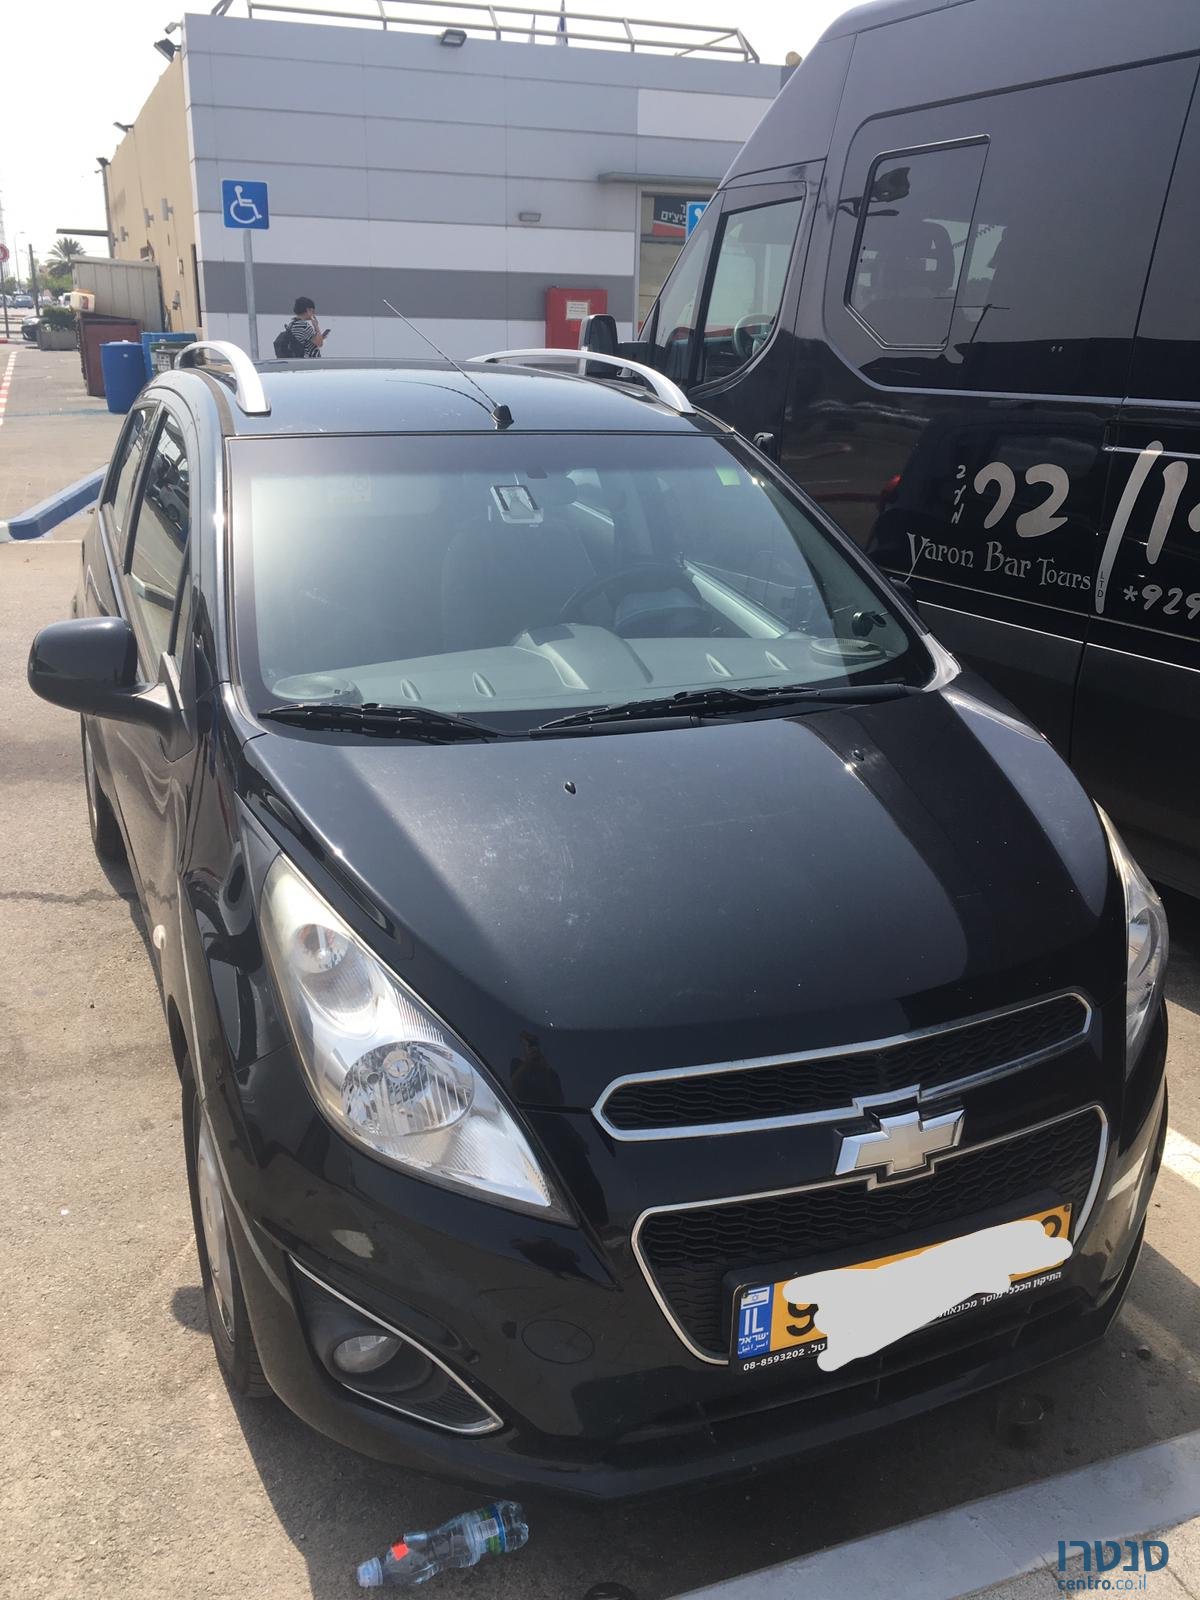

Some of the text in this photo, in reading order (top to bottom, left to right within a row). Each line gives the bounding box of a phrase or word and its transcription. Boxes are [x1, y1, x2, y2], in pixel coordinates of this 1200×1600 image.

[906, 532, 974, 584] Yaron
[984, 540, 1032, 578] Bar
[1037, 557, 1091, 590] Tours
[1033, 1271, 1062, 1288] התיקון
[744, 1307, 764, 1335] IL
[738, 1332, 769, 1345] ישראל
[743, 1348, 805, 1371] 08-8593202
